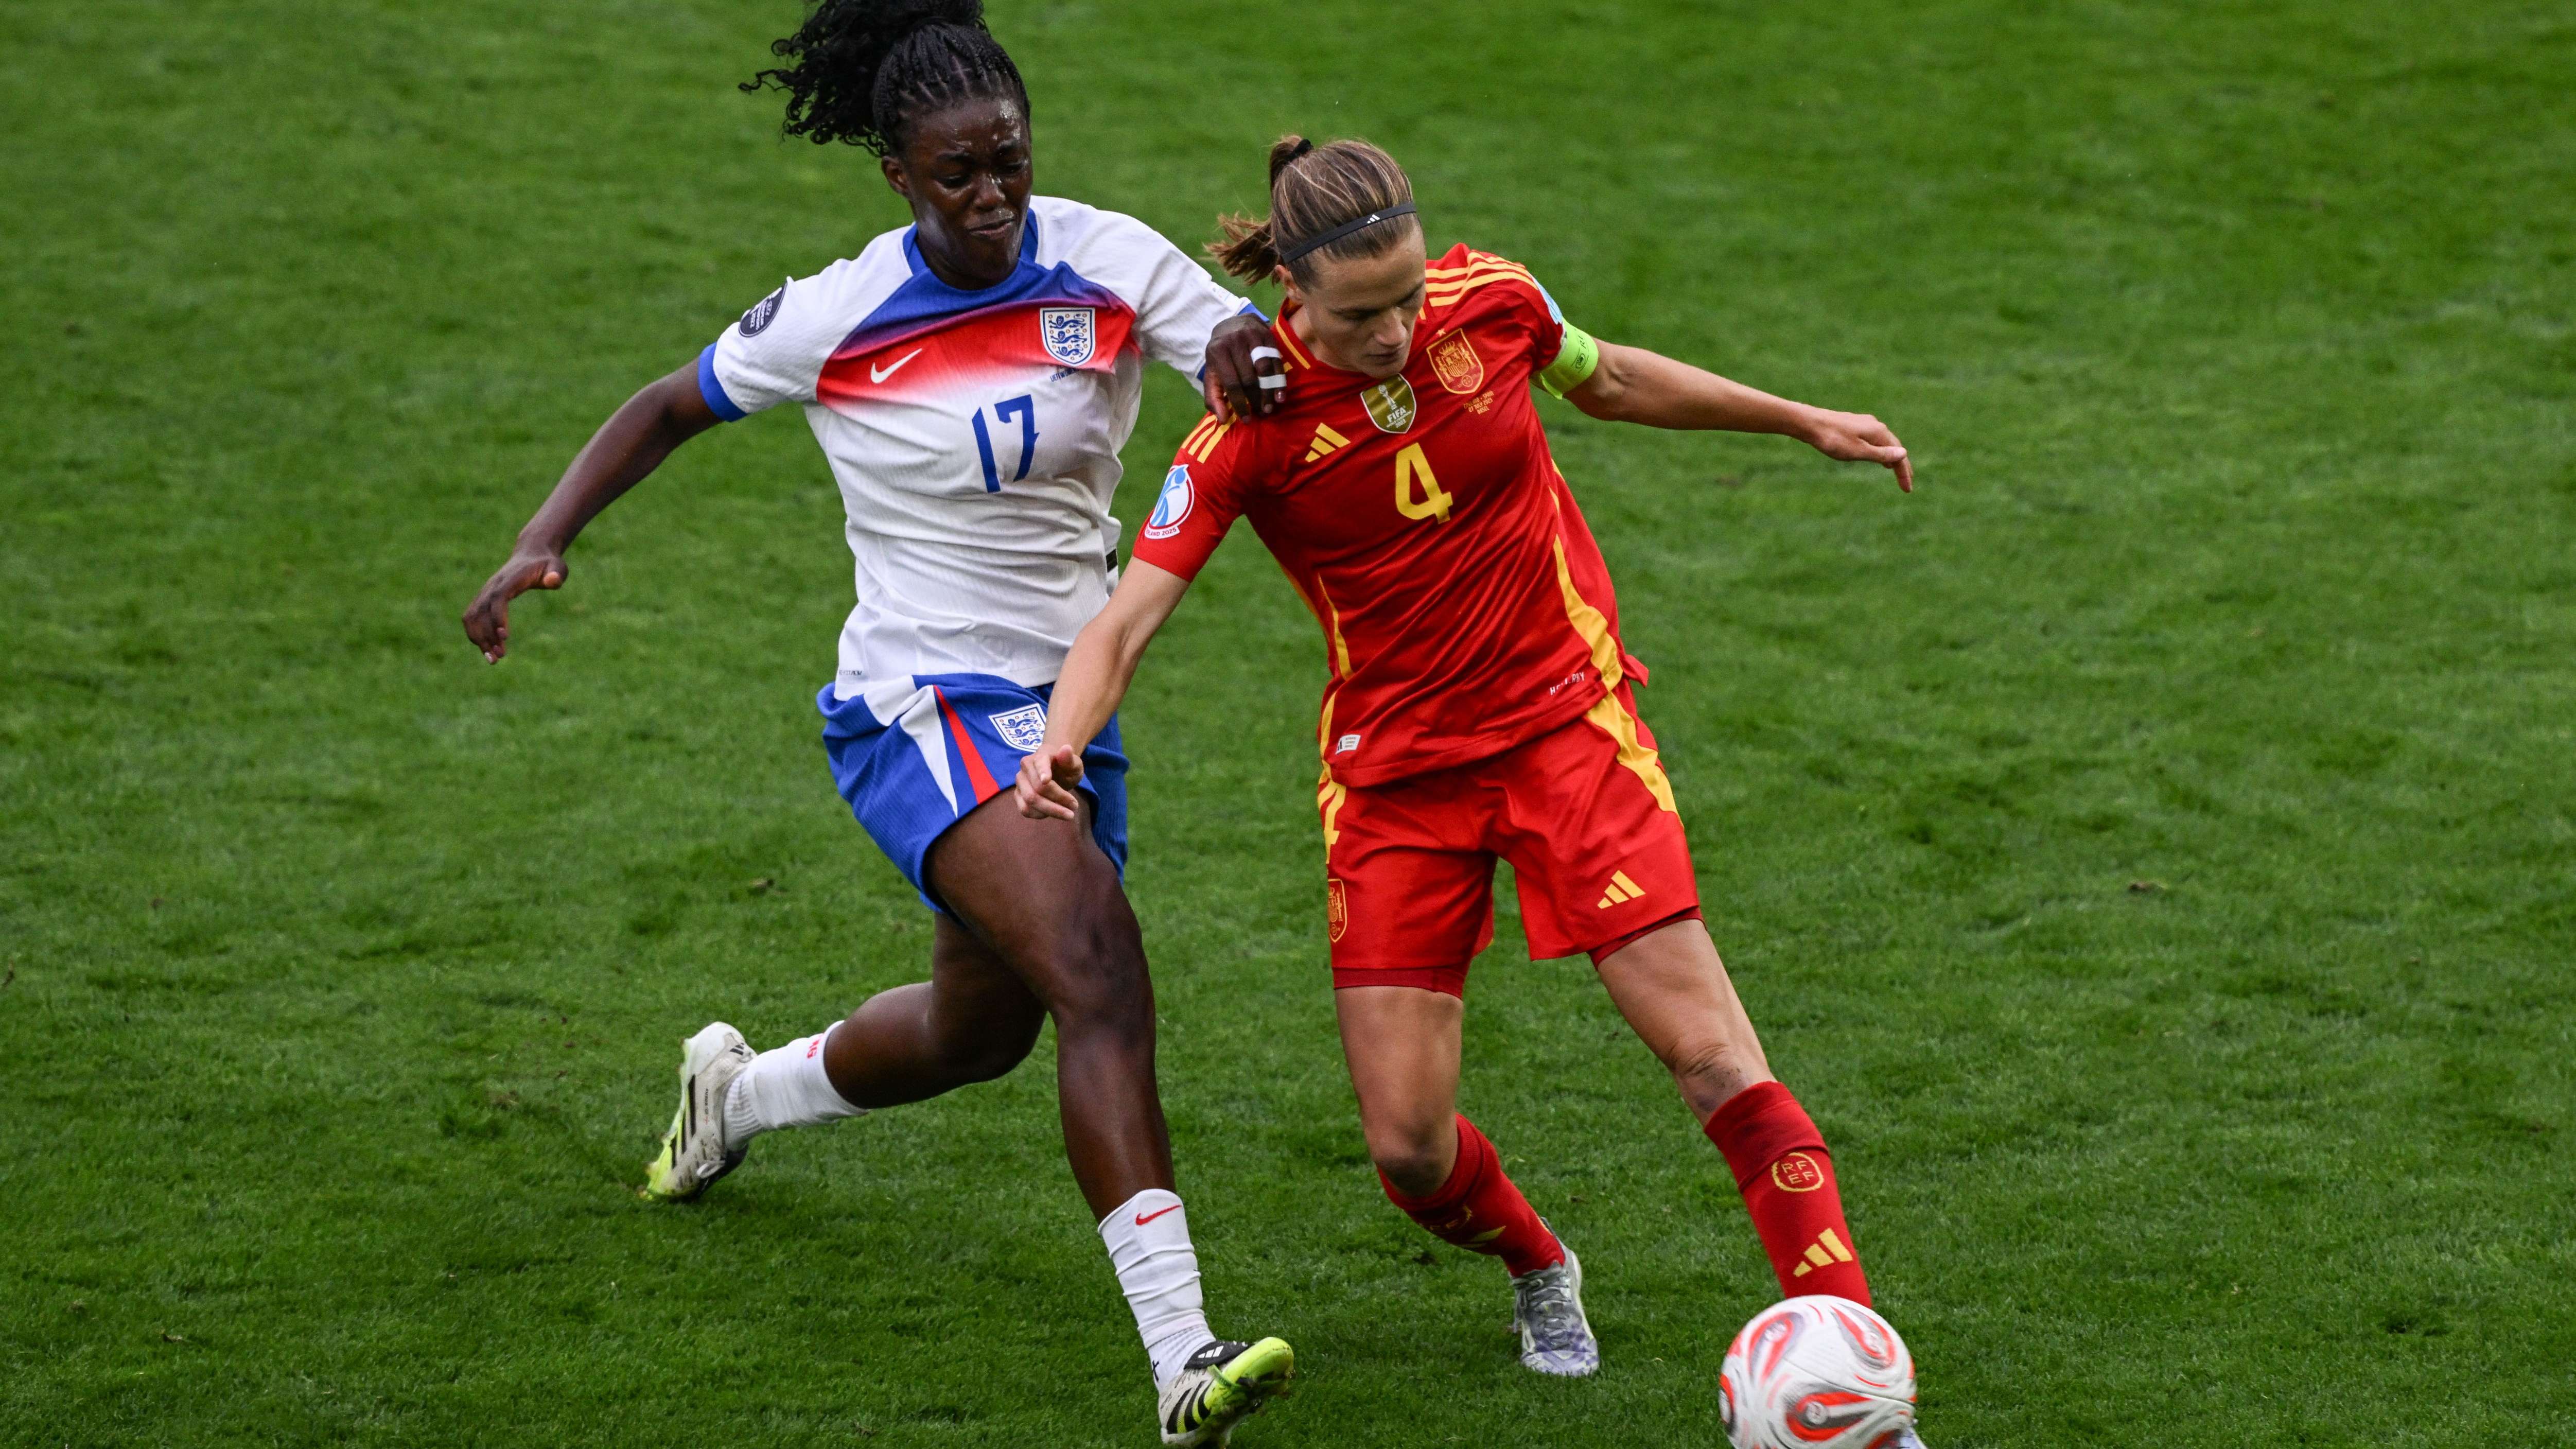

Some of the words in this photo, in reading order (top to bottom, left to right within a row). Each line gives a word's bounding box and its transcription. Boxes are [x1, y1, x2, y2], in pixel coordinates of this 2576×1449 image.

[1387, 407, 1407, 423] FIFA
[971, 394, 1040, 493] 17
[1395, 442, 1453, 525] 4
[1162, 527, 1177, 536] 2025
